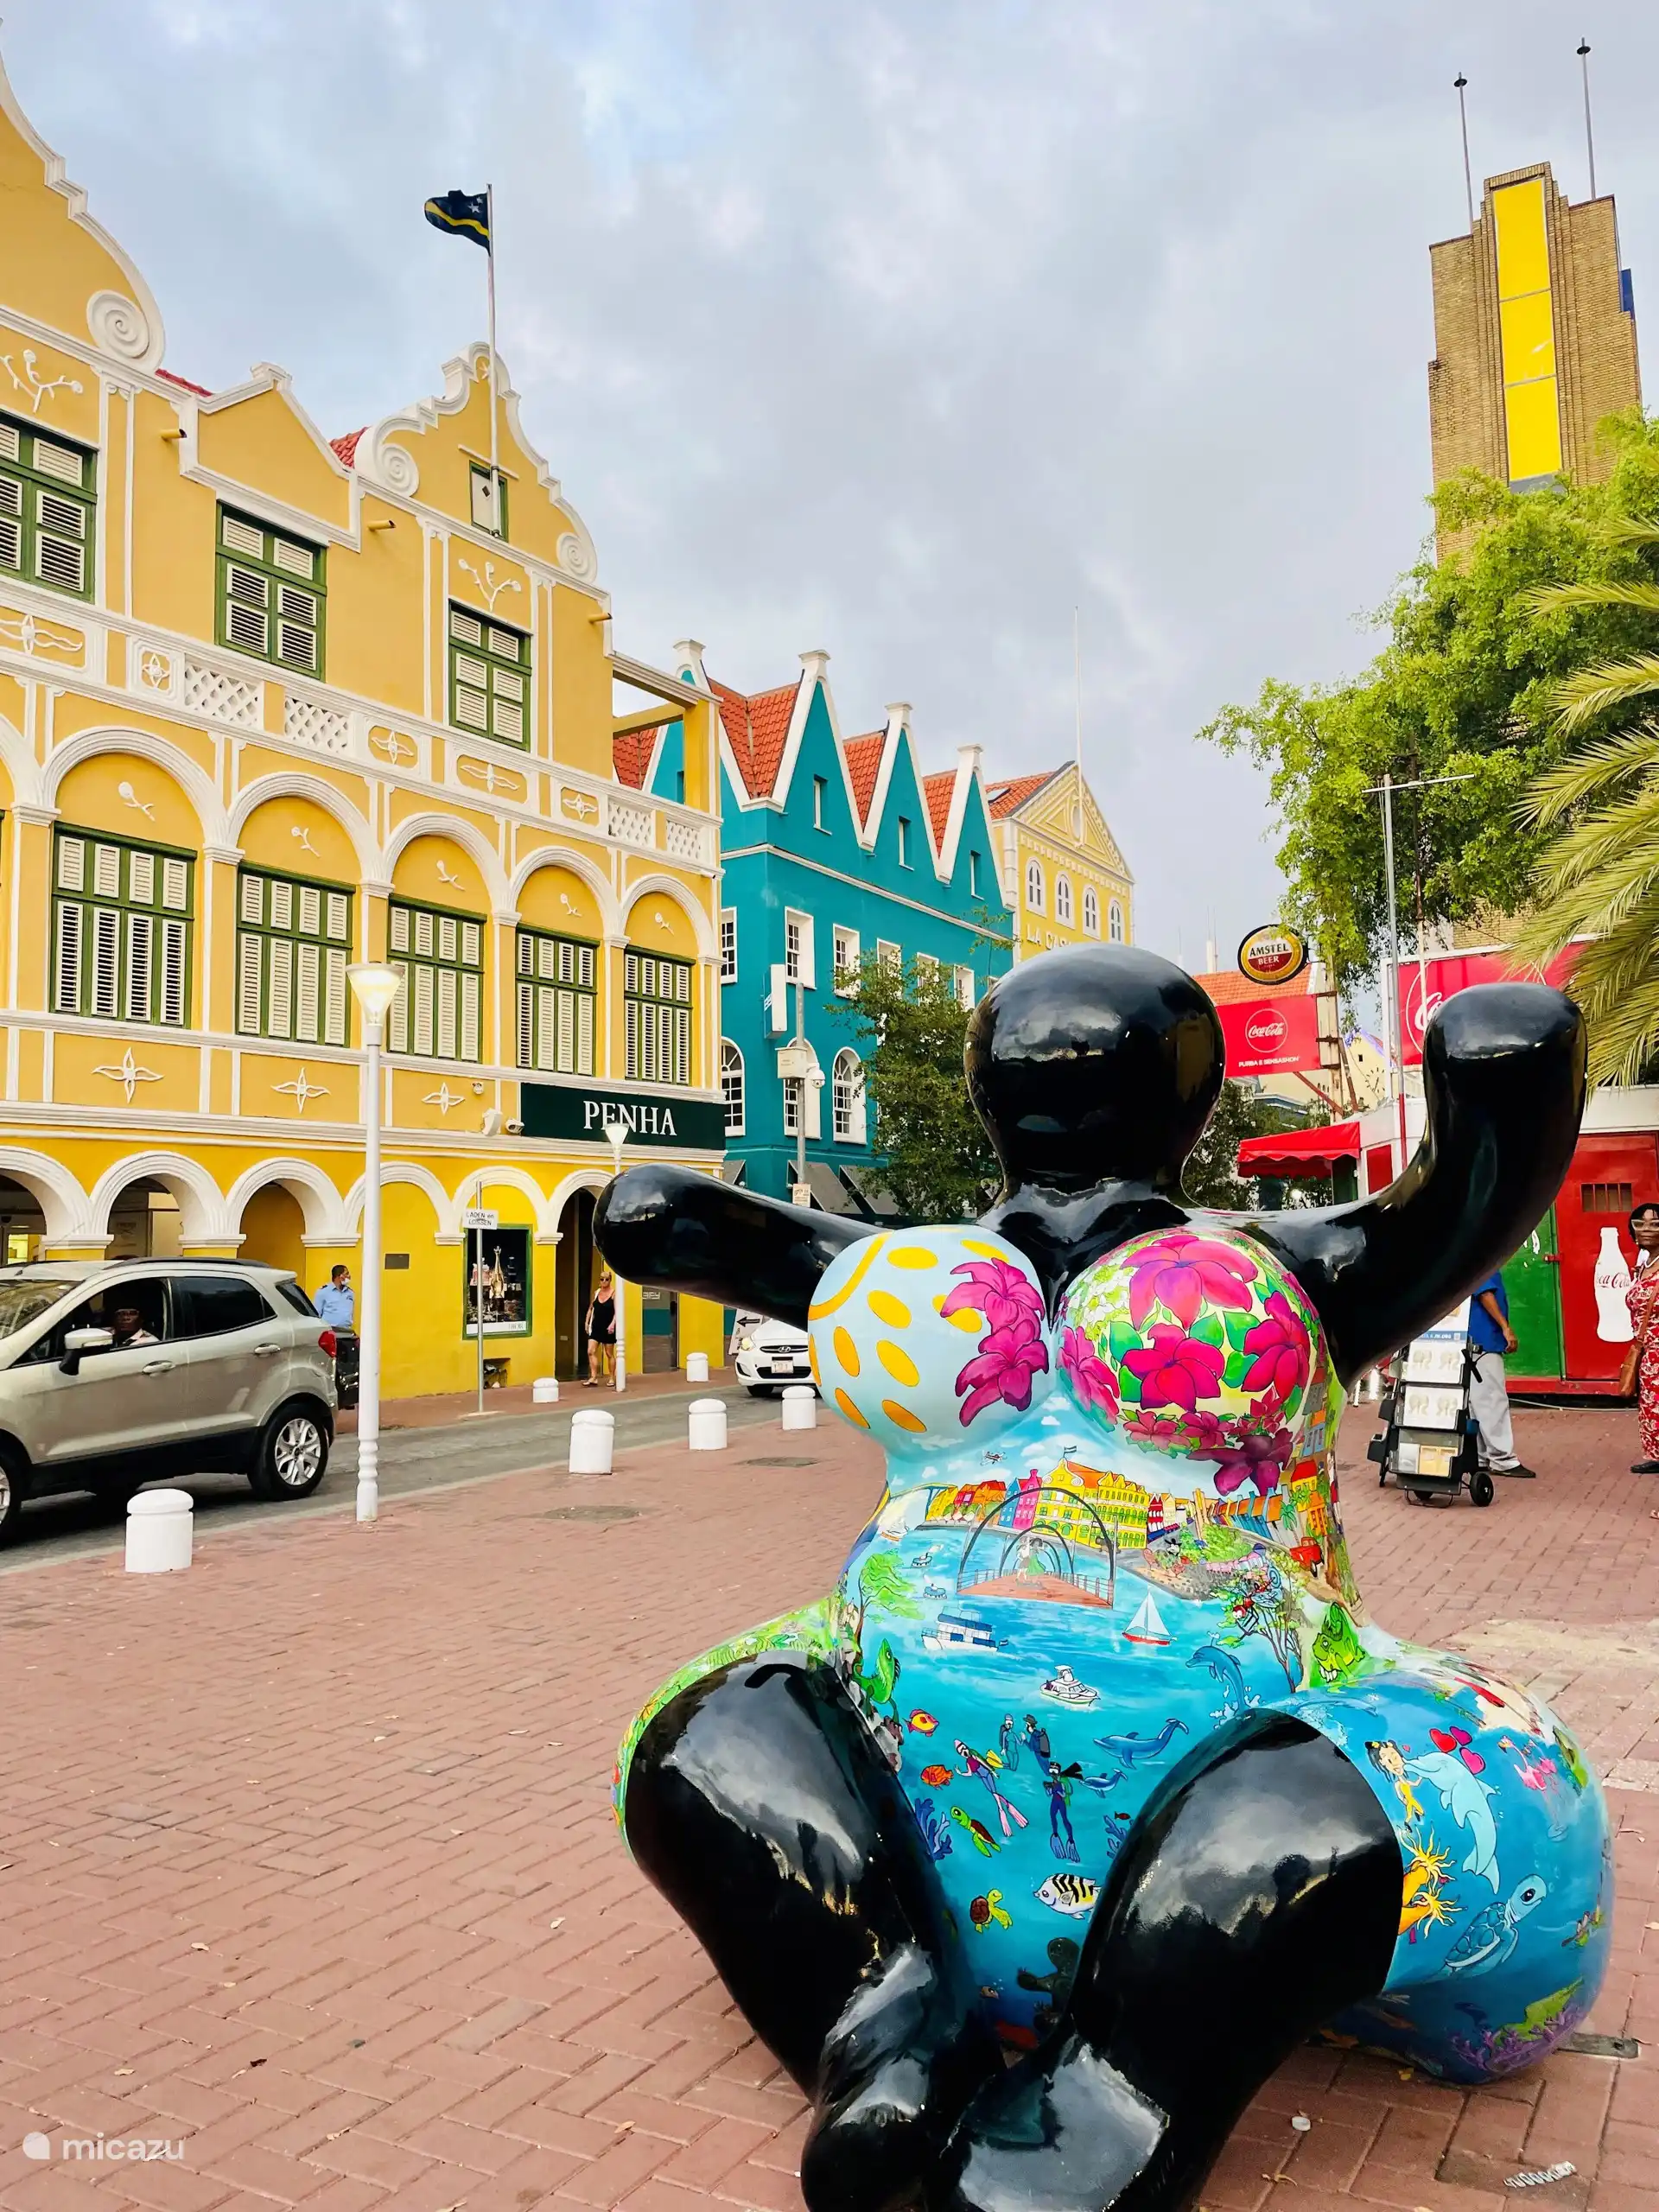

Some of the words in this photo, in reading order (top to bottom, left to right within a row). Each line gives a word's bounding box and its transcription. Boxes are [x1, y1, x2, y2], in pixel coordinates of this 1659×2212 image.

[1027, 924, 1041, 946] LA
[1249, 944, 1289, 957] AMSTEL
[1258, 956, 1280, 965] BEER
[582, 1100, 677, 1136] PENHA
